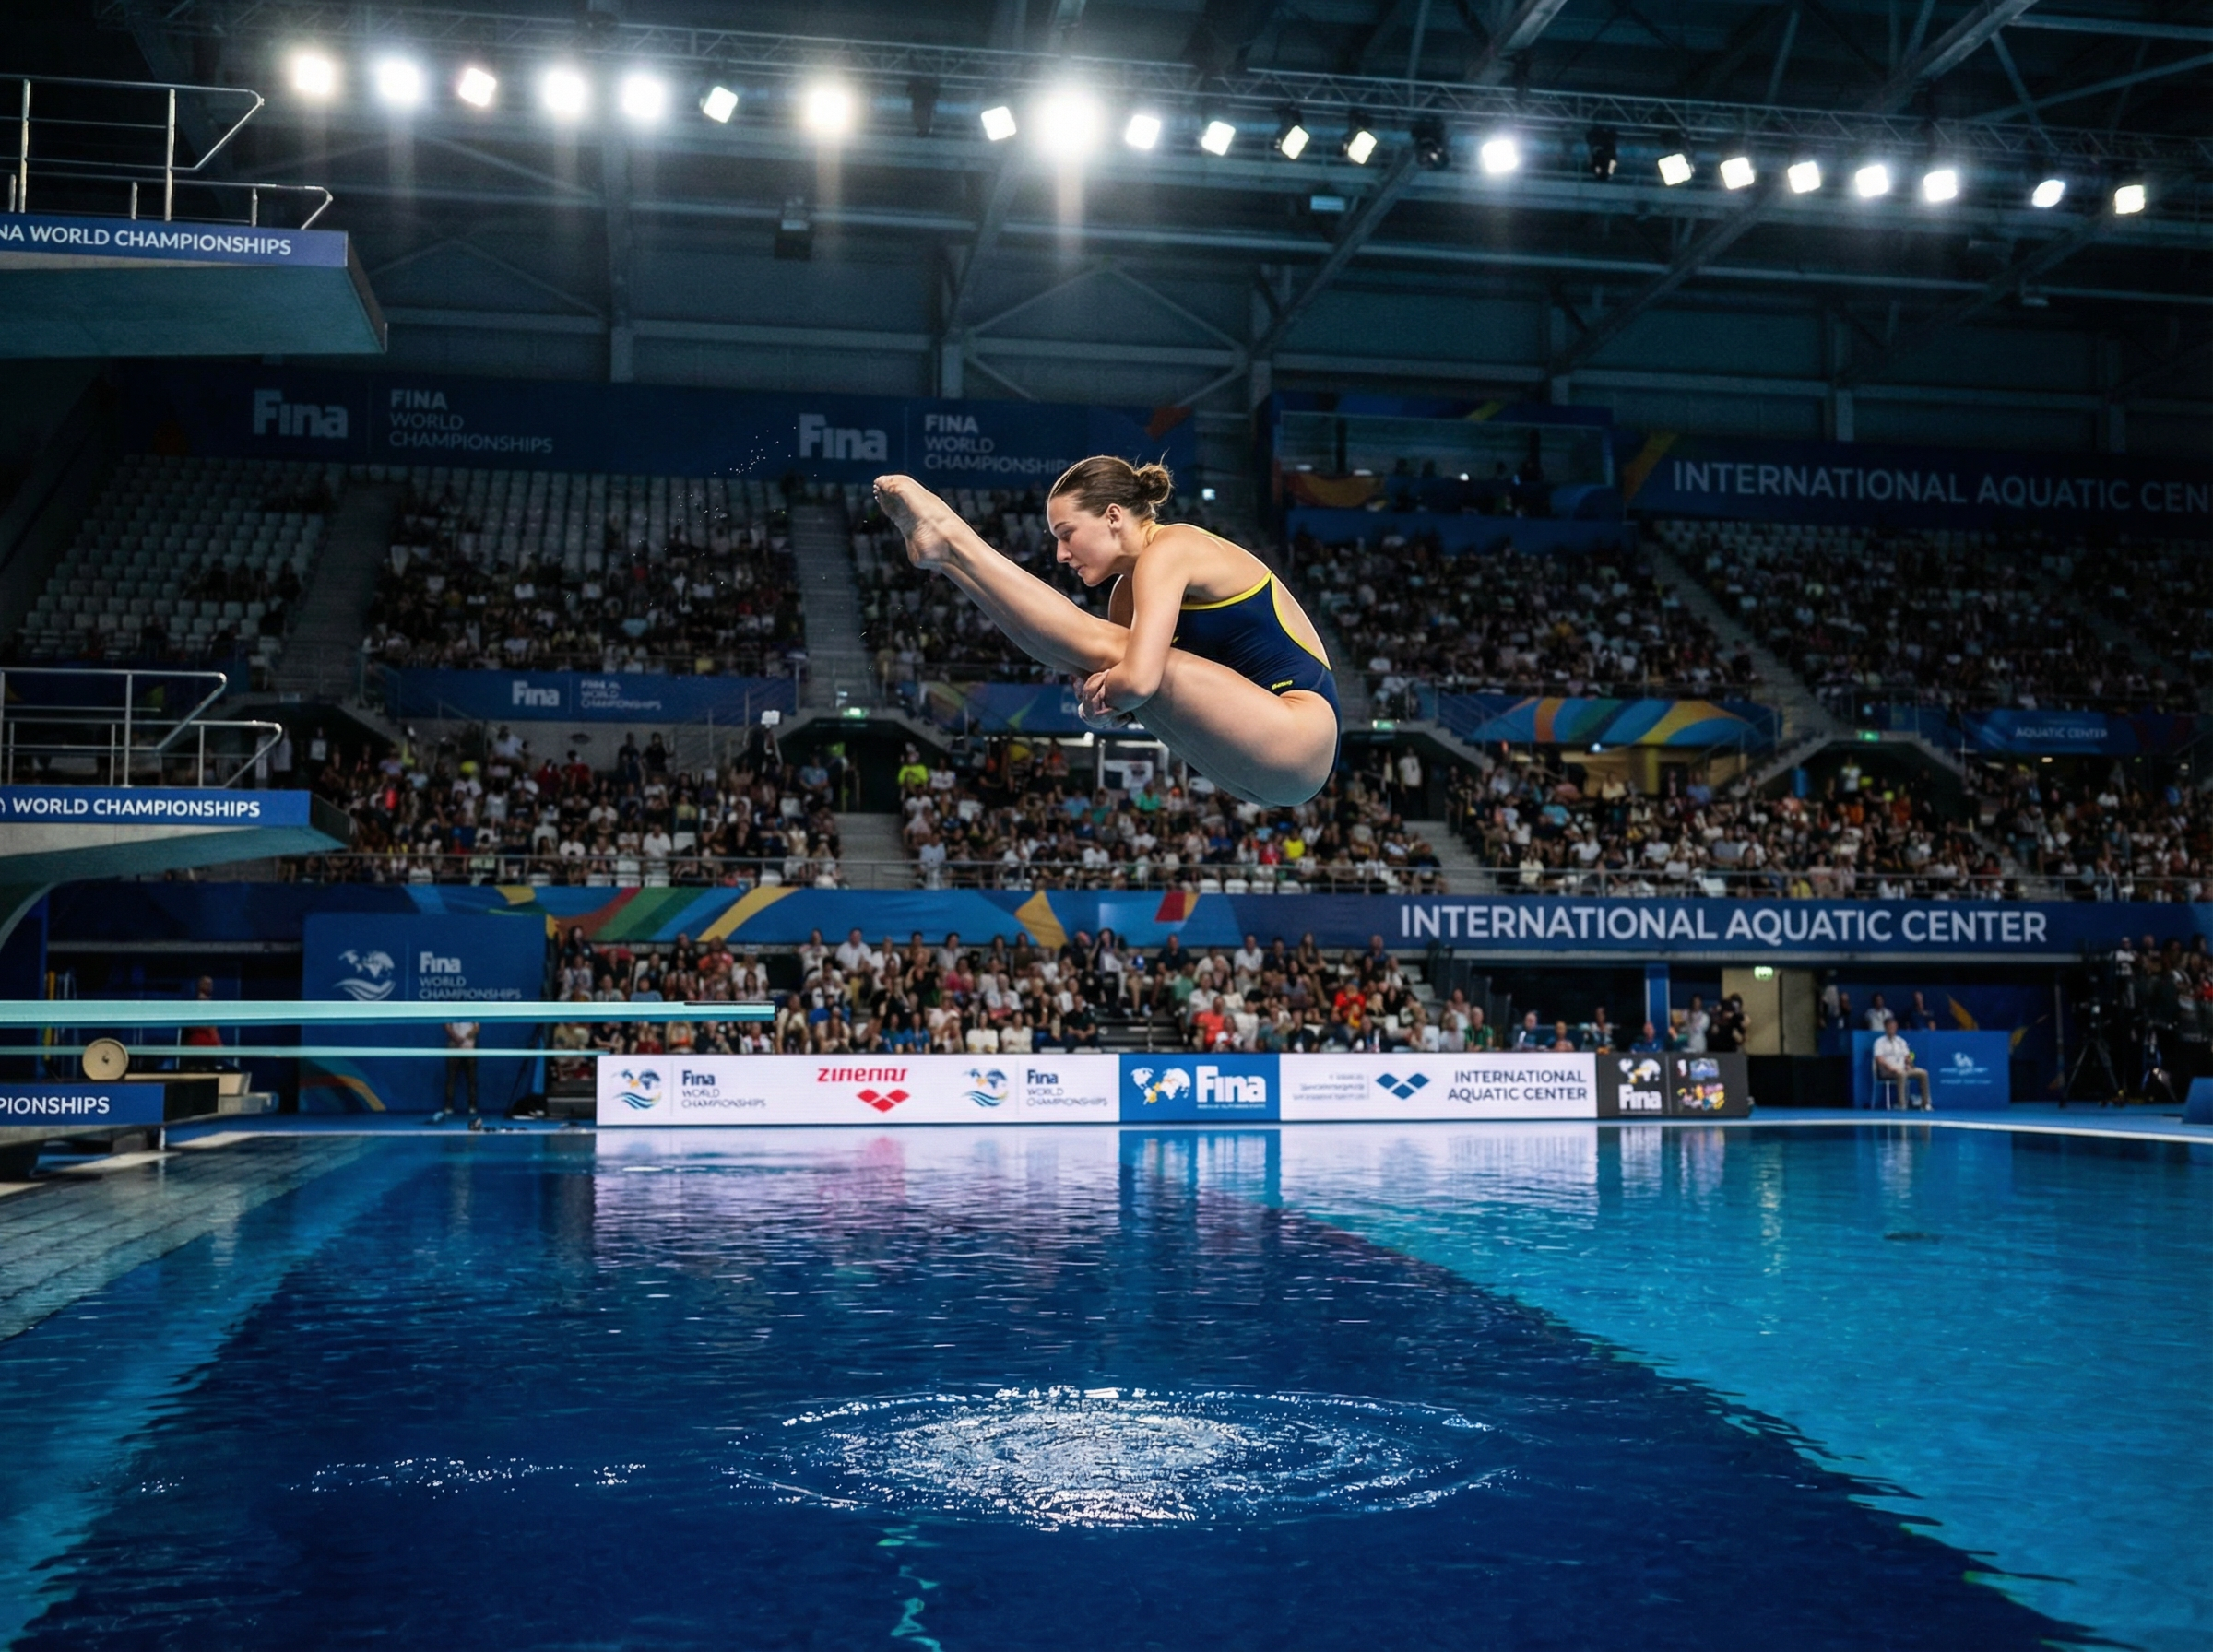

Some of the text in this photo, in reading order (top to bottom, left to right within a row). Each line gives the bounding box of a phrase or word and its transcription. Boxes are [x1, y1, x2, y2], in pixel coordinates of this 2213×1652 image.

[29, 225, 110, 246] WORLD
[114, 230, 291, 255] CHAMPIONSHIPS
[390, 389, 448, 410] FINA
[253, 389, 348, 439] Fina
[390, 412, 464, 431] WORLD
[925, 414, 979, 434] FINA
[389, 431, 552, 454] CHAMPIONSHIPS
[799, 413, 888, 461] Fina
[925, 435, 994, 454] WORLD
[925, 454, 1073, 475] CHAMPIONSHIP
[1674, 461, 2209, 513] INTERNATIONAL AQUATIC CEN
[513, 680, 560, 707] Fina
[12, 797, 260, 818] WORLD CHAMPIONSHIPS
[1401, 905, 2047, 946] INTERNATIONAL AQUATIC CENTER
[420, 951, 461, 973] Fina
[419, 976, 467, 988] WORLD
[419, 988, 522, 1001] CHAMPIONSHIPS
[682, 1070, 716, 1086] Fina
[1027, 1069, 1059, 1085] Fina
[1196, 1065, 1267, 1103] Fina
[1454, 1069, 1587, 1083] INTERNATIONAL
[1448, 1087, 1588, 1103] AQUATIC CENTER
[1618, 1083, 1663, 1110] Fina
